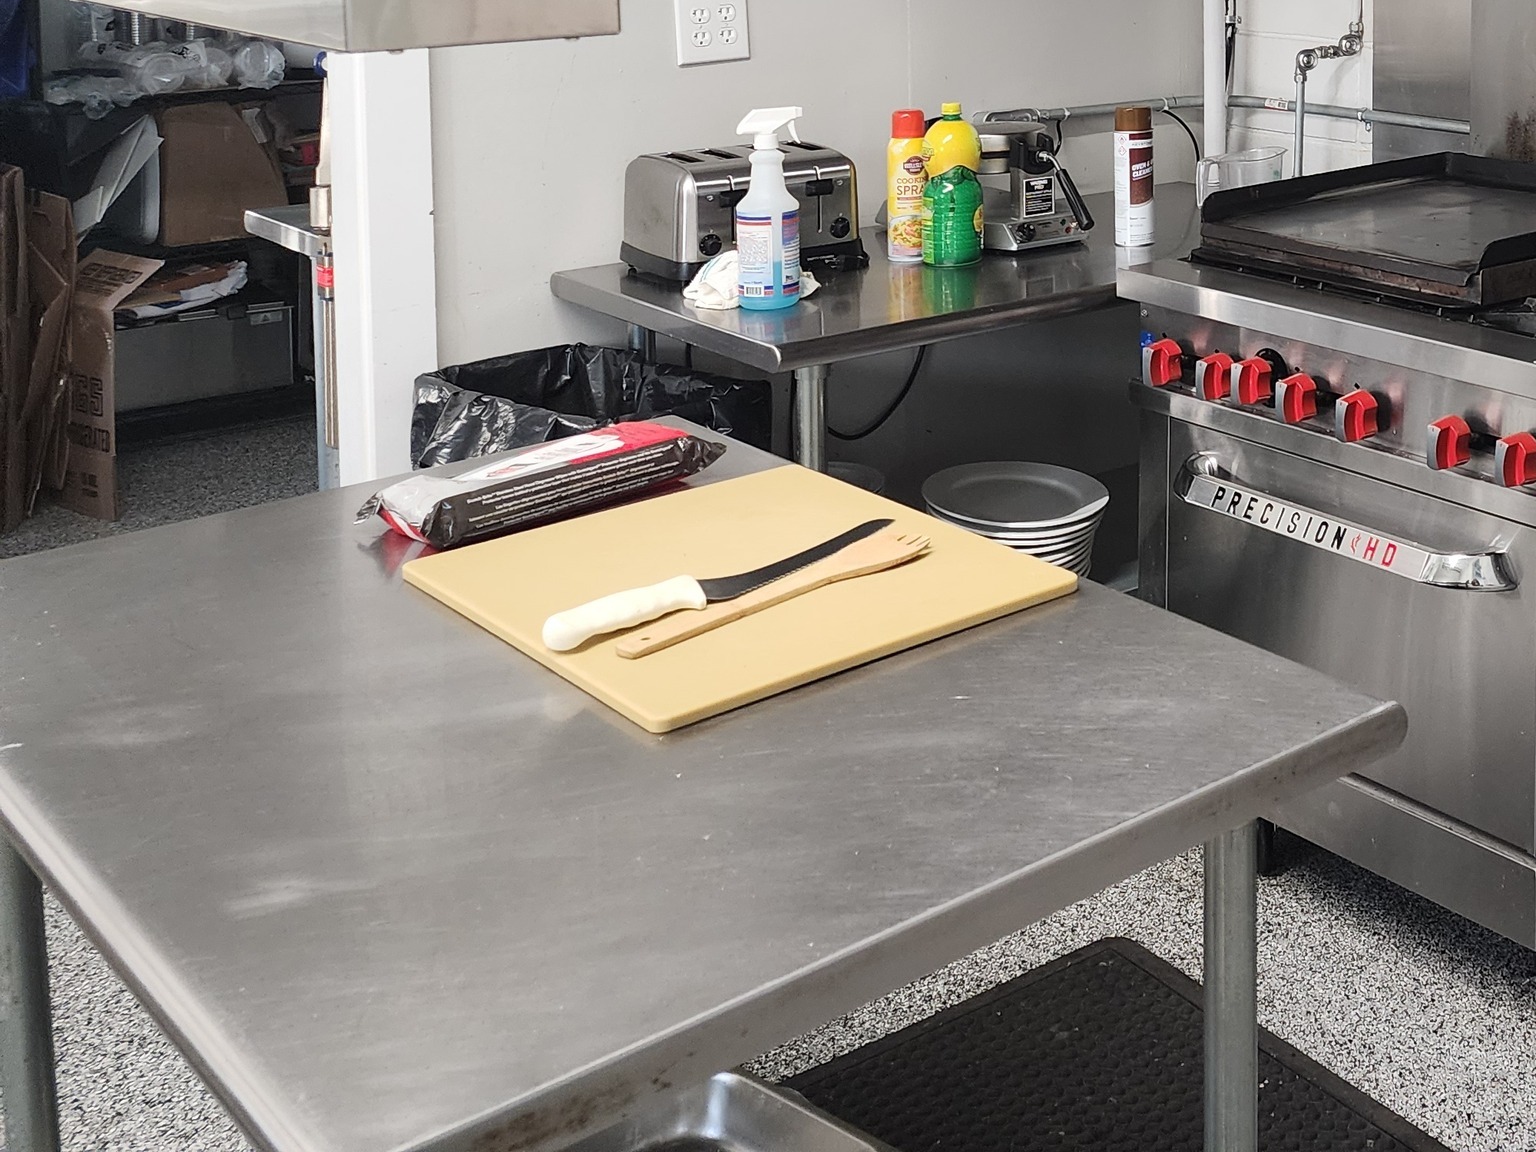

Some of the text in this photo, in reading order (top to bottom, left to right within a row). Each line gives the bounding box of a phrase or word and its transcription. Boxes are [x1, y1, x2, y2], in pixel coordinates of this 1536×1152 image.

[896, 177, 925, 185] COOKIN
[896, 184, 924, 196] SPRA
[1210, 485, 1398, 568] PRECISION HD
